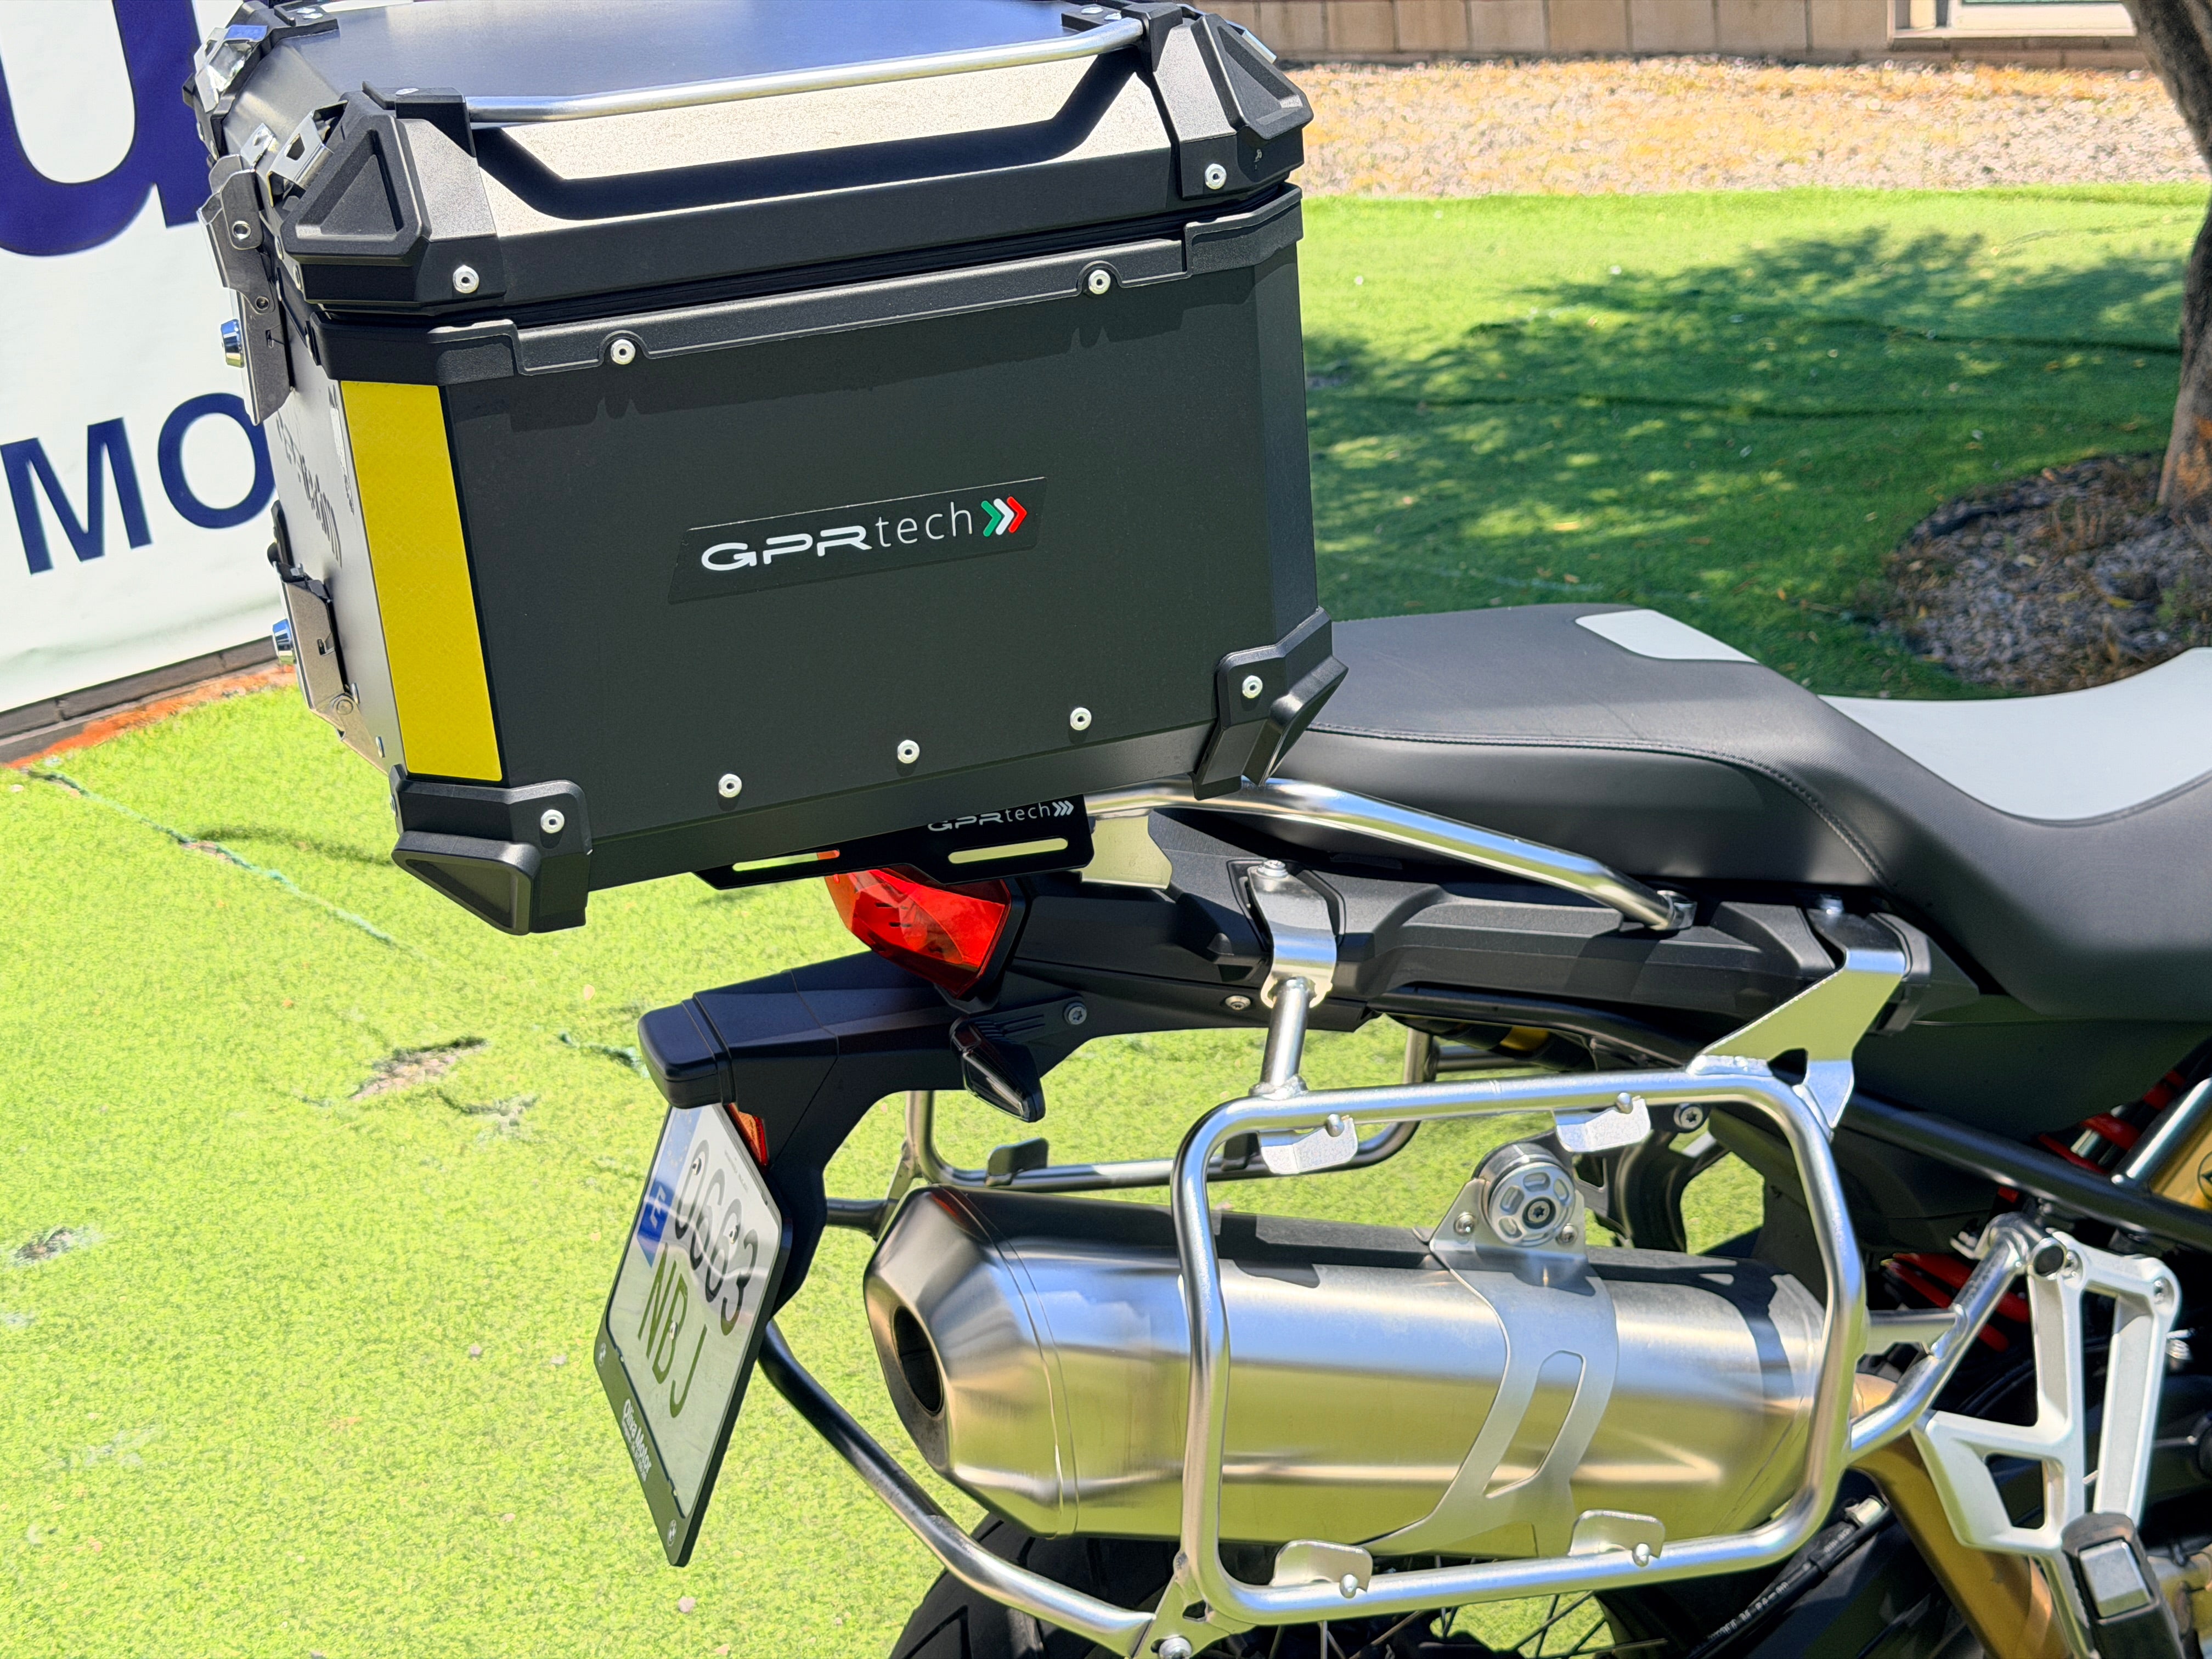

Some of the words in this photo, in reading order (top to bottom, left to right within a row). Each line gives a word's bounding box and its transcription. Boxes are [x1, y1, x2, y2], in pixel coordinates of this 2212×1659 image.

[701, 501, 973, 571] GPRtech
[650, 1185, 666, 1229] E
[675, 1139, 758, 1336] 0663
[638, 1242, 708, 1418] NBJ
[623, 1398, 637, 1439] Oliva
[635, 1426, 652, 1474] Motor
